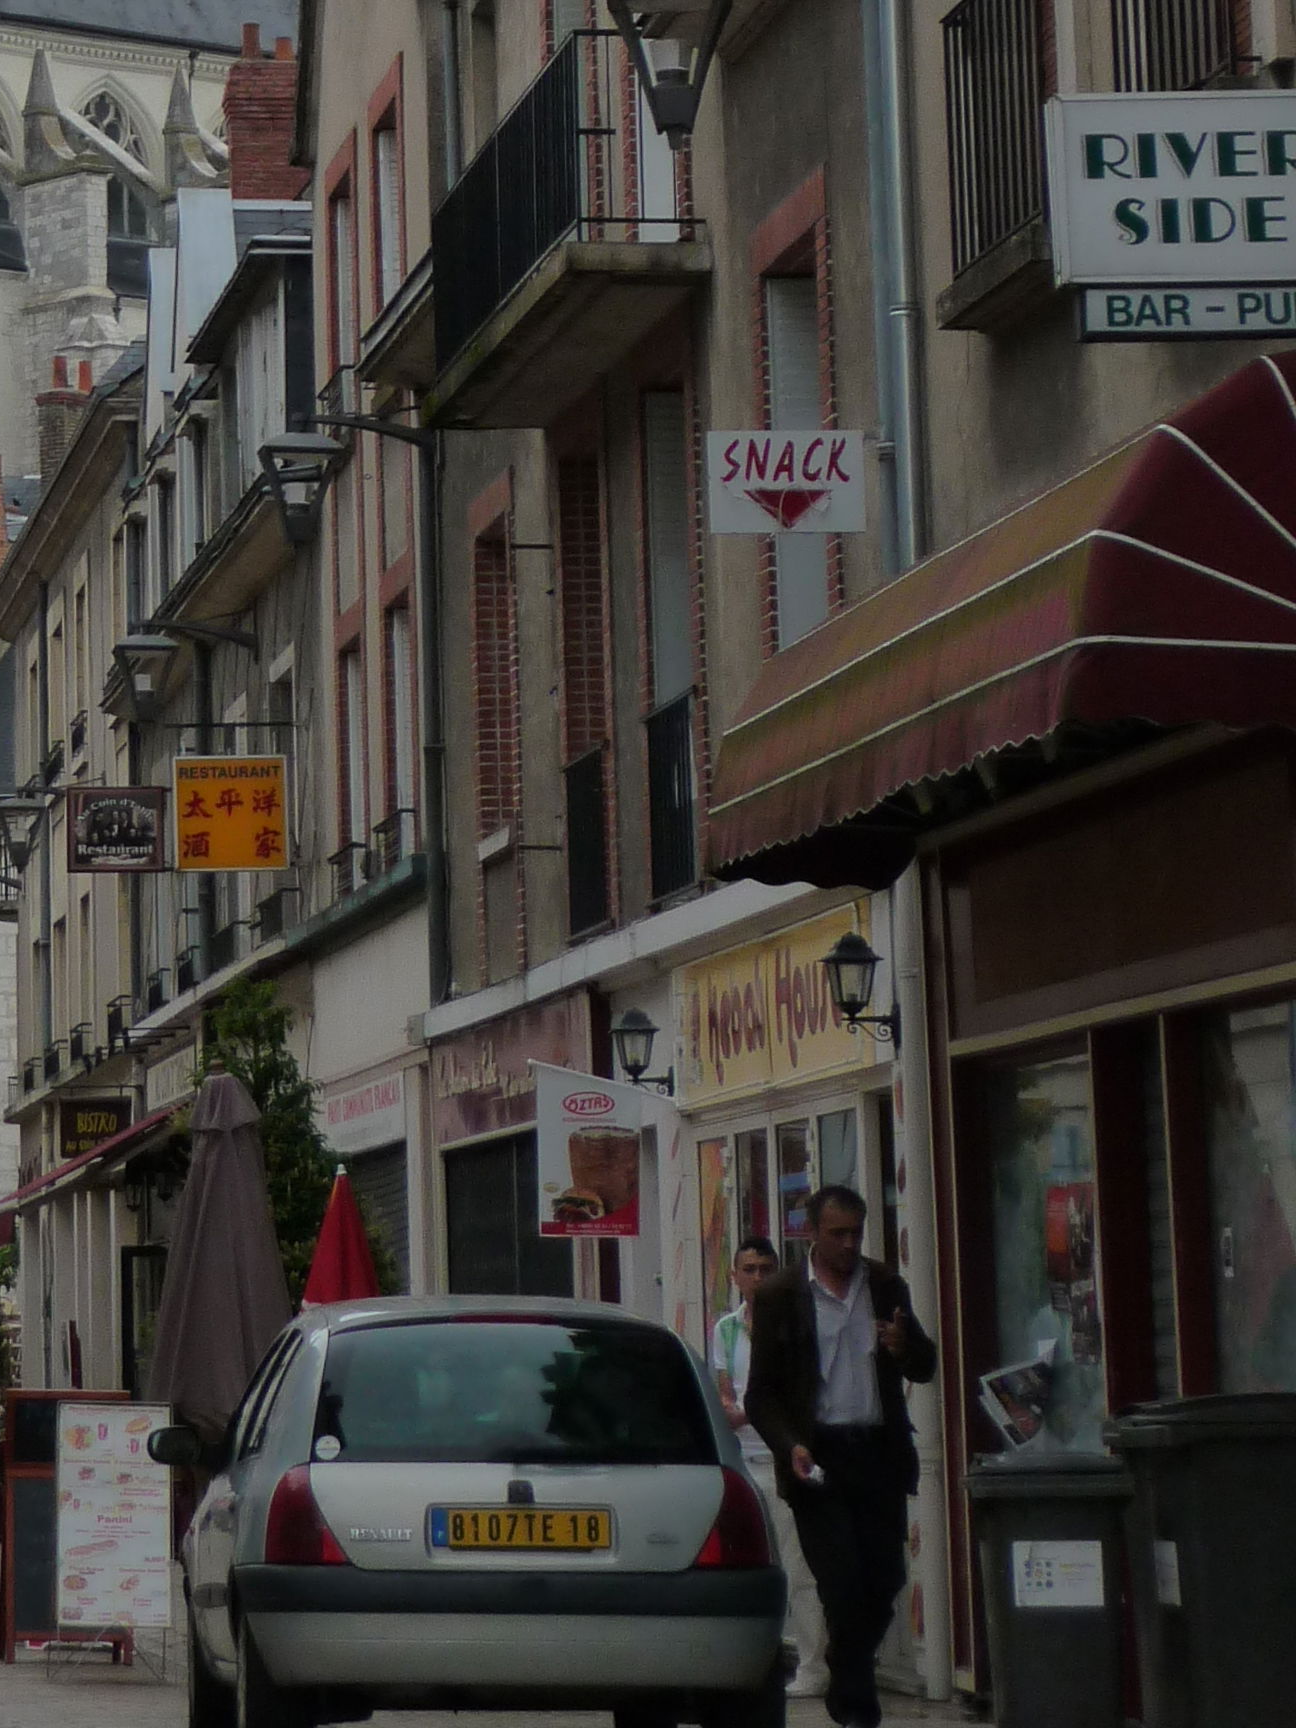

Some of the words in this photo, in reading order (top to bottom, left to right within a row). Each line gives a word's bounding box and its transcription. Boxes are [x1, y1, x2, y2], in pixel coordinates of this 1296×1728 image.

[1083, 130, 1296, 179] RIVER
[1114, 196, 1288, 245] SIDE
[1106, 293, 1191, 327] BAR
[1237, 291, 1296, 325] PU
[720, 437, 851, 483] SNACK
[178, 765, 282, 780] RESTAURANT
[182, 787, 283, 819] 太平洋
[77, 843, 154, 856] Restaurant
[77, 1111, 118, 1134] BISTRO
[97, 1514, 133, 1524] Panini
[350, 1527, 413, 1541] RENAULT
[451, 1512, 556, 1543] 8107TE
[569, 1514, 600, 1544] 18
